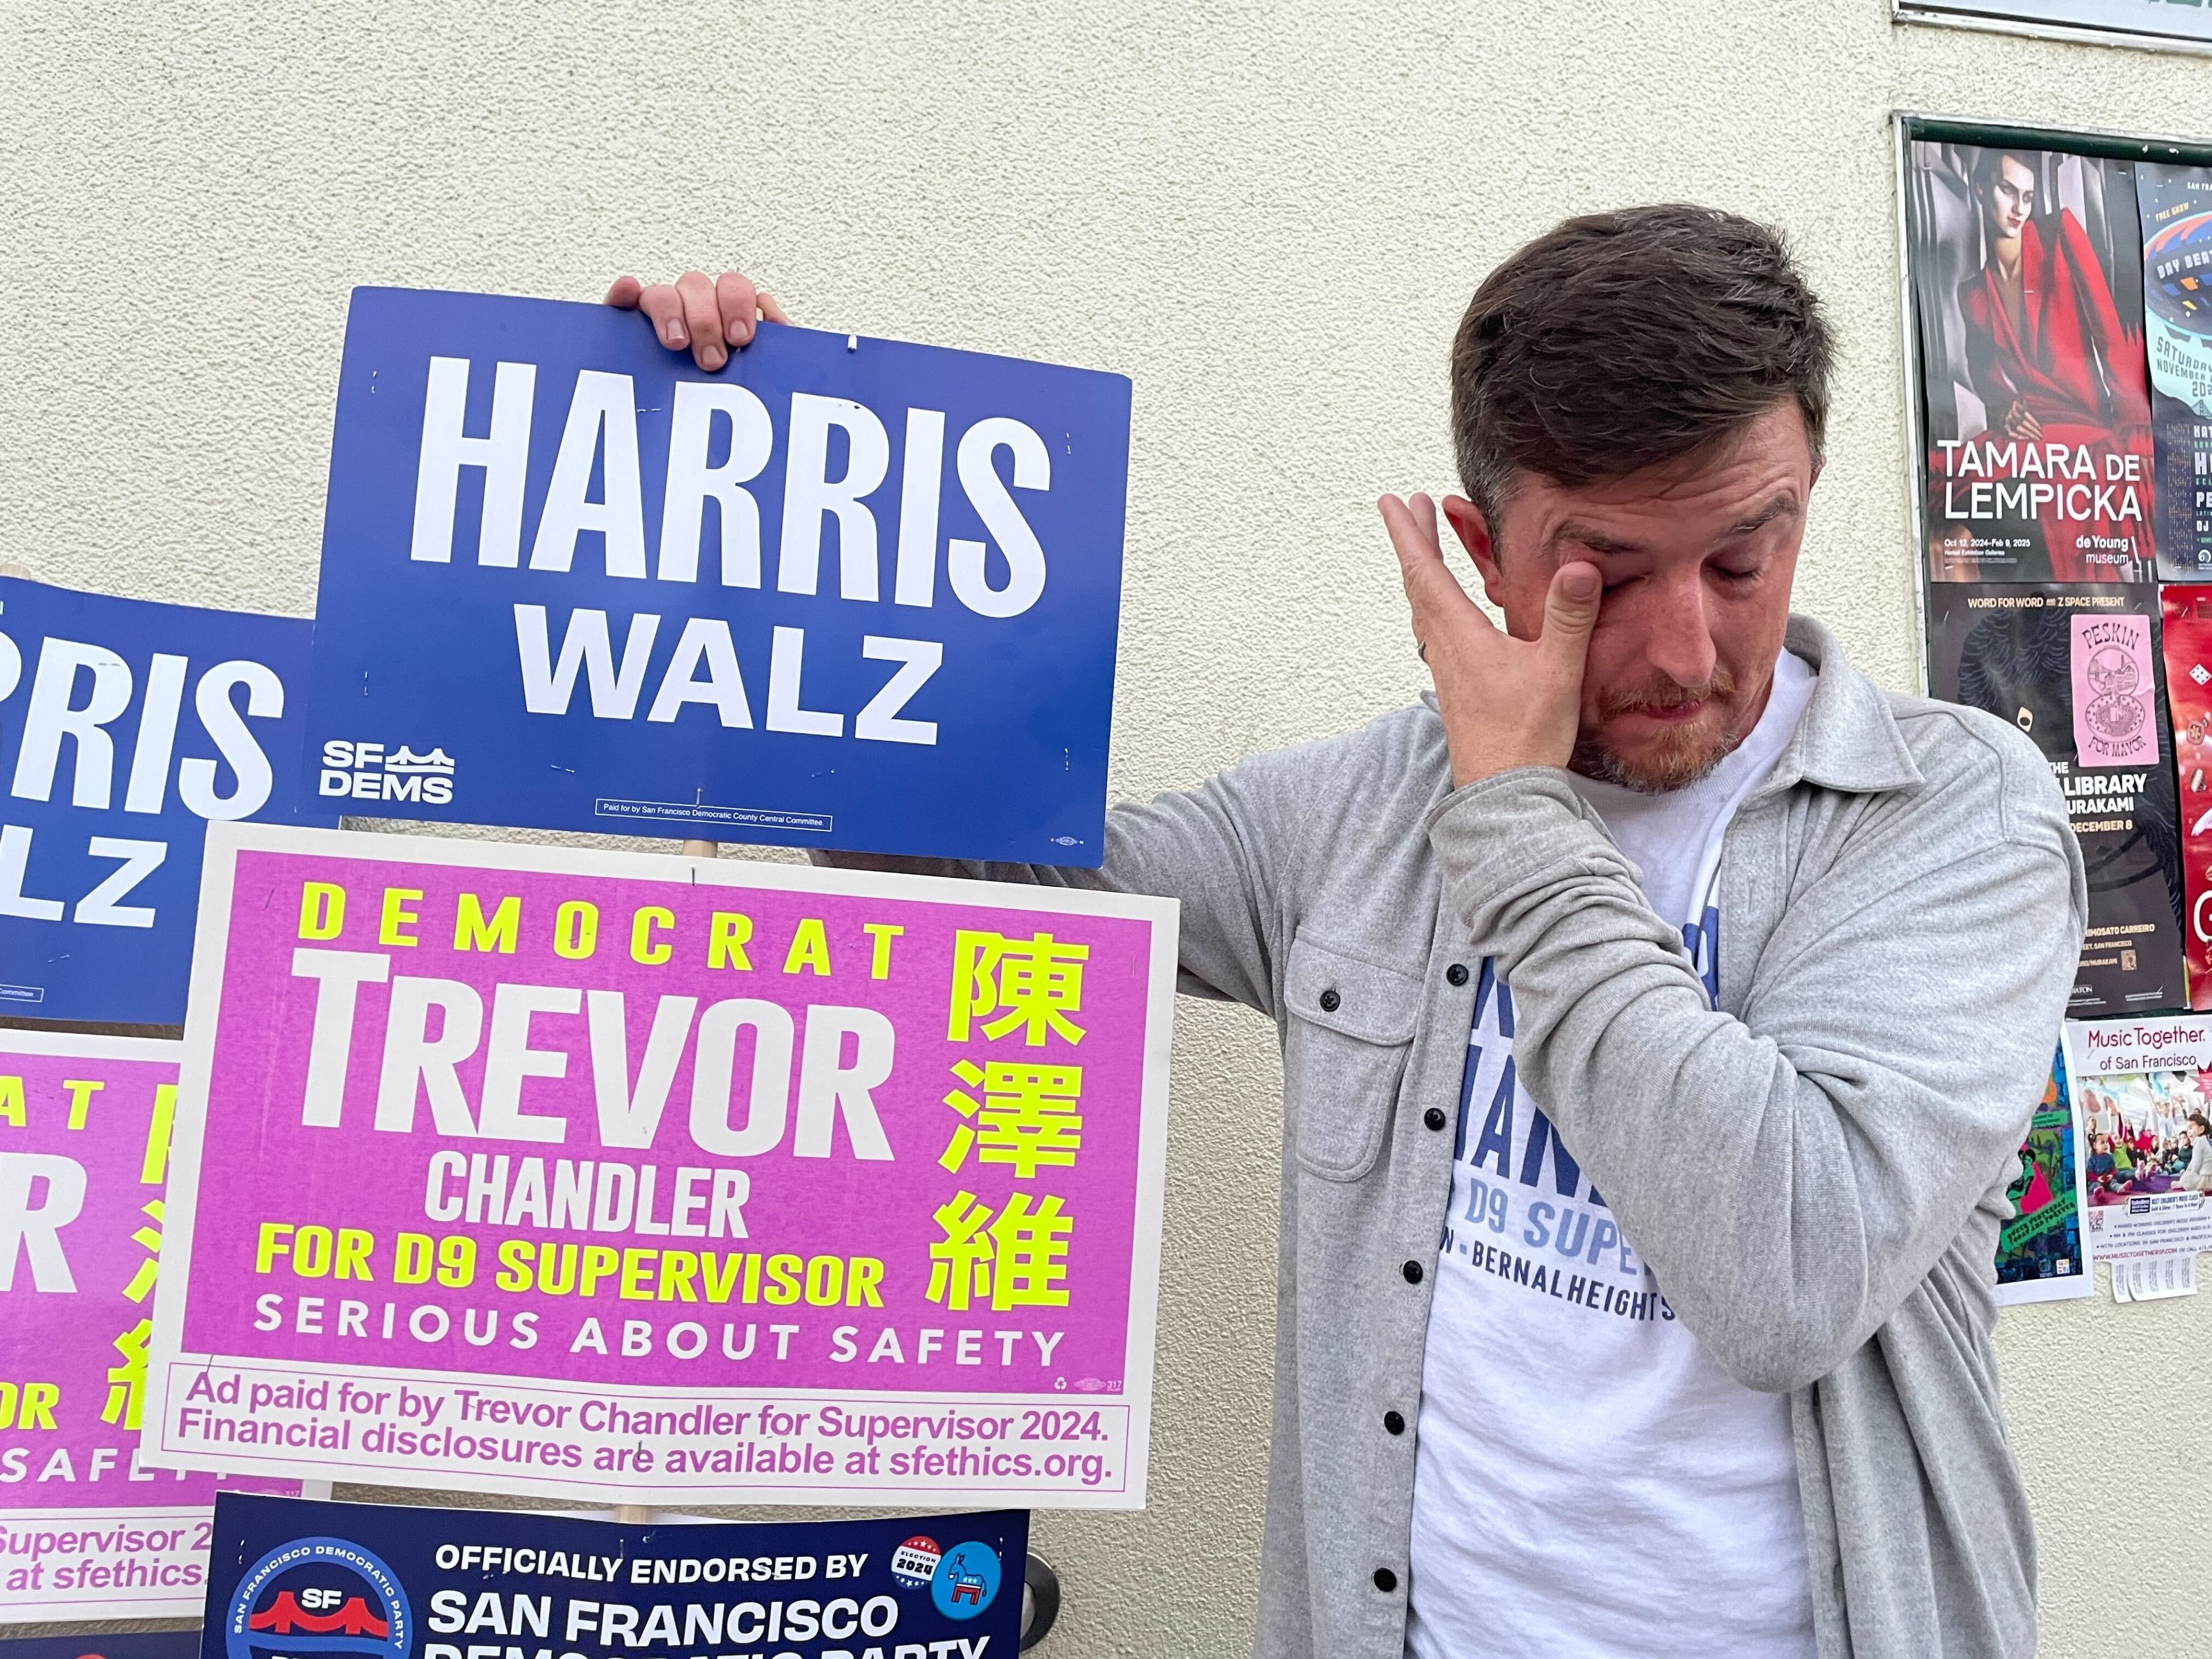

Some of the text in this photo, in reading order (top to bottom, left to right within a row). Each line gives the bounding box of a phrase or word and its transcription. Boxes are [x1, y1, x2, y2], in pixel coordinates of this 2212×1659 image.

[2187, 182, 2200, 190] SAN
[2156, 209, 2171, 222] FREE
[2157, 259, 2180, 279] BAY
[2157, 358, 2206, 381] NOVEMBER
[1937, 440, 2140, 481] TAMARA DE
[410, 355, 1051, 618] HARRIS
[1945, 482, 2142, 521] LEMPICKA
[2196, 520, 2209, 532] DJ
[1944, 539, 1957, 547] Oct
[1959, 539, 1968, 548] 12,
[2013, 539, 2031, 547] 2025
[2086, 553, 2129, 564] museum
[1968, 598, 1997, 608] WORD
[1998, 598, 2015, 608] FOR
[2016, 597, 2044, 608] WORD
[2058, 597, 2064, 607] Z
[2065, 597, 2091, 607] SPACE
[2092, 596, 2125, 607] PRESENT
[2082, 623, 2139, 650] PESKIN
[513, 603, 944, 745] WALZ
[323, 740, 385, 769] SF
[2088, 735, 2147, 757] FOR MAYOR
[319, 769, 454, 805] DEMS
[2063, 773, 2147, 796] LIBRARY
[603, 803, 619, 812] Paid
[620, 804, 630, 812] for
[631, 805, 641, 814] by
[642, 806, 656, 814] San
[657, 806, 691, 816] Francisco
[692, 809, 732, 819] Democratic
[733, 812, 758, 823] County
[759, 814, 785, 823] Central
[2126, 819, 2133, 830] 8
[0, 824, 168, 928] LZ
[297, 881, 904, 980] DEMOCRAT
[2088, 1029, 2133, 1049] Music
[290, 947, 896, 1161] TREVOR
[2100, 1053, 2196, 1070] of San Francisco
[0, 1075, 105, 1130] AT
[925, 929, 1090, 1312] 陳澤維
[424, 1150, 750, 1240] CHANDLER
[0, 1152, 87, 1293] R
[1464, 1177, 1652, 1277] D9 SUPE
[255, 1222, 885, 1309] FOR D9 SUPERVISOR
[253, 1293, 1065, 1367] SERIOUS ABOUT SAFETY
[1106, 1380, 1123, 1388] 317
[186, 1372, 1109, 1445] Ad paid for by Trevor Chandler for Supervisor 2024.
[178, 1407, 1112, 1484] Financial disclosures are available at sfethics.org.
[435, 1544, 868, 1584] OFFICIALLY ENDORSED BY
[896, 1558, 933, 1575] 2024
[900, 1551, 936, 1563] ELECTION
[6, 1562, 45, 1591] at
[234, 1603, 247, 1634] SAN
[243, 1547, 311, 1600] FRANCISCO
[315, 1546, 395, 1597] DEMOCRATIC
[391, 1600, 404, 1649] PARTY
[301, 1588, 342, 1608] SF
[427, 1589, 899, 1646] SAN FRANCISCO
